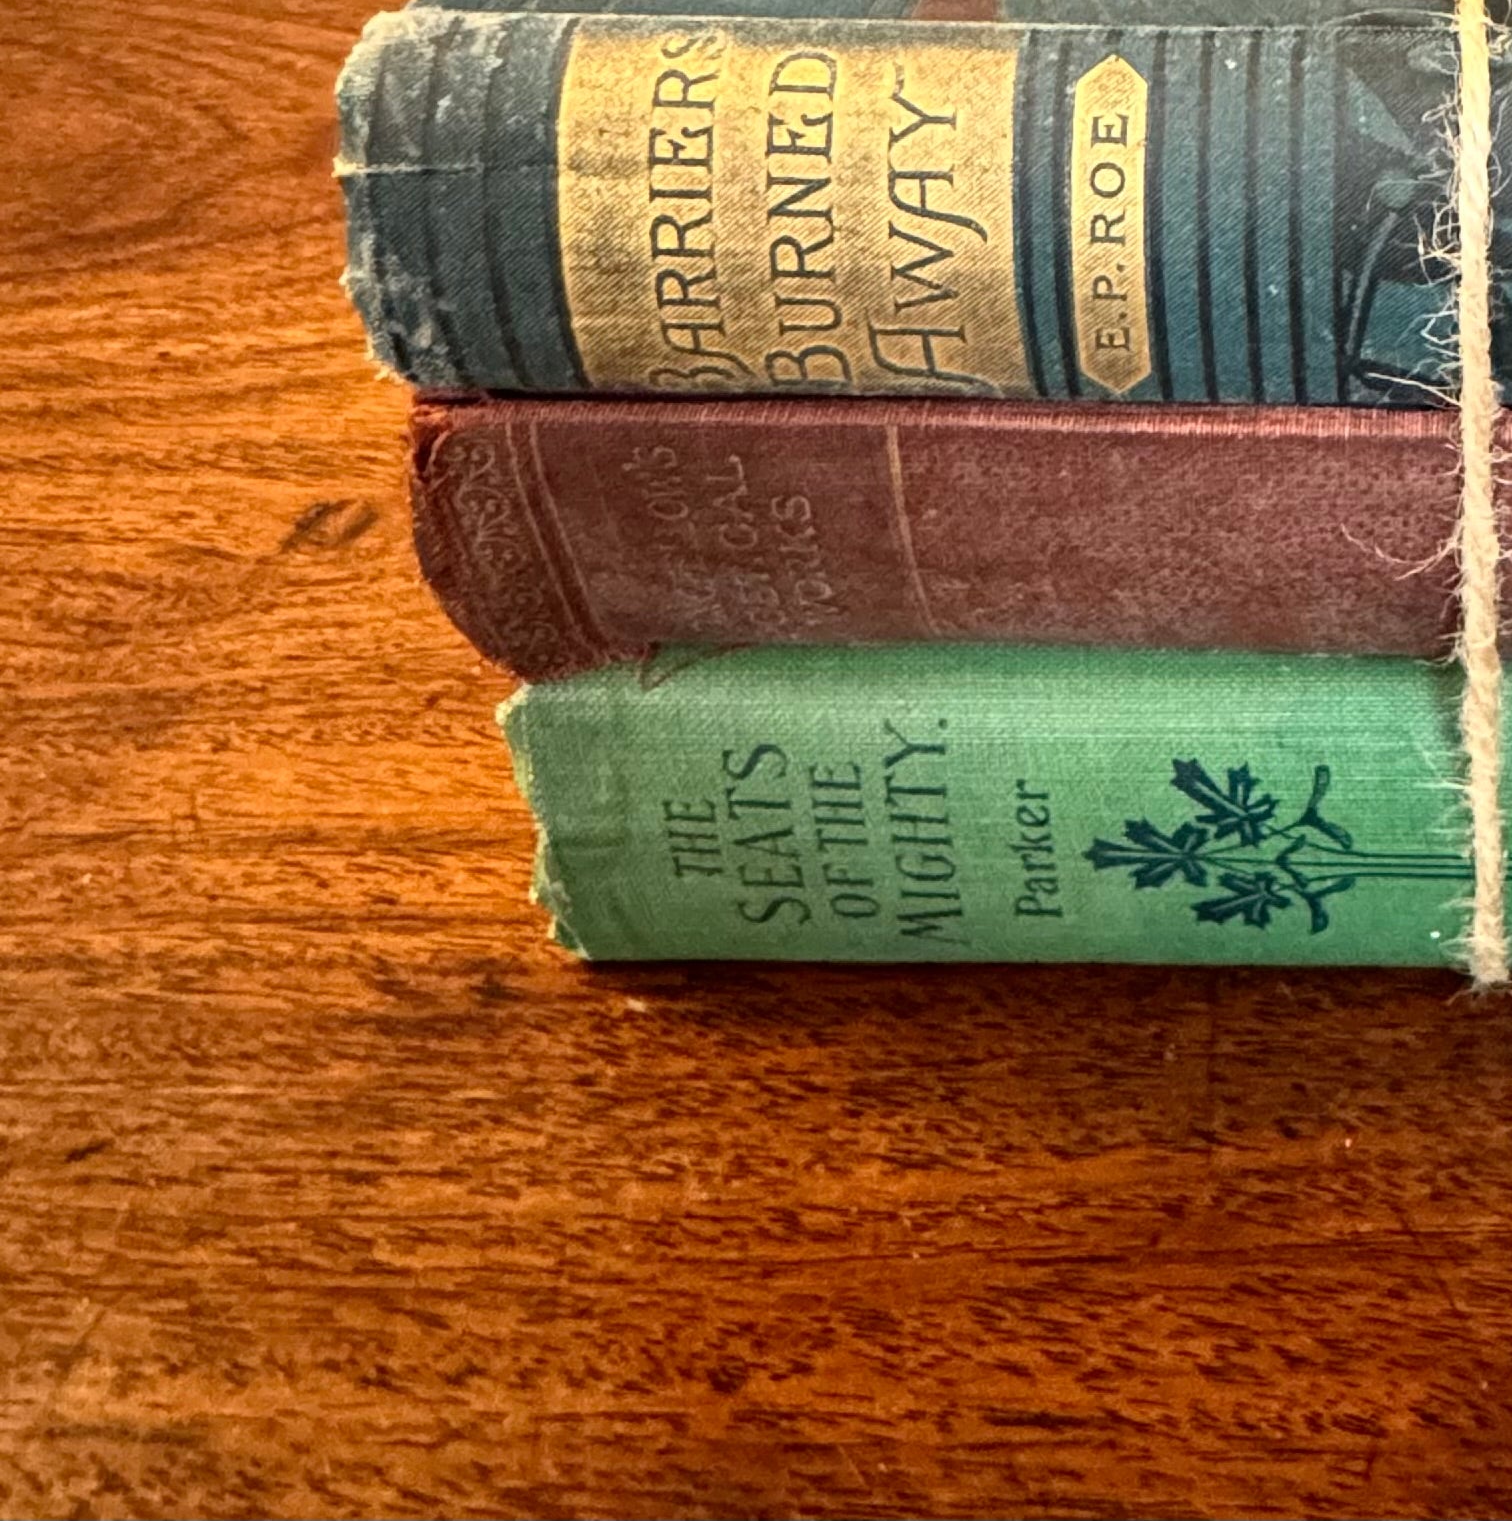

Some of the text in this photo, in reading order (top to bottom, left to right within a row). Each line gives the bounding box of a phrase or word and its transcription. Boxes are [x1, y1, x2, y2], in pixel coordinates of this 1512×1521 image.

[649, 29, 757, 385] BARRIERS
[764, 49, 853, 386] BURNED
[863, 65, 1003, 398] AWAY
[662, 797, 724, 879] THE
[722, 743, 812, 925] SEATS
[808, 760, 881, 919] OF THE
[883, 717, 971, 947] MIGHTY.
[1010, 778, 1065, 918] Parker
